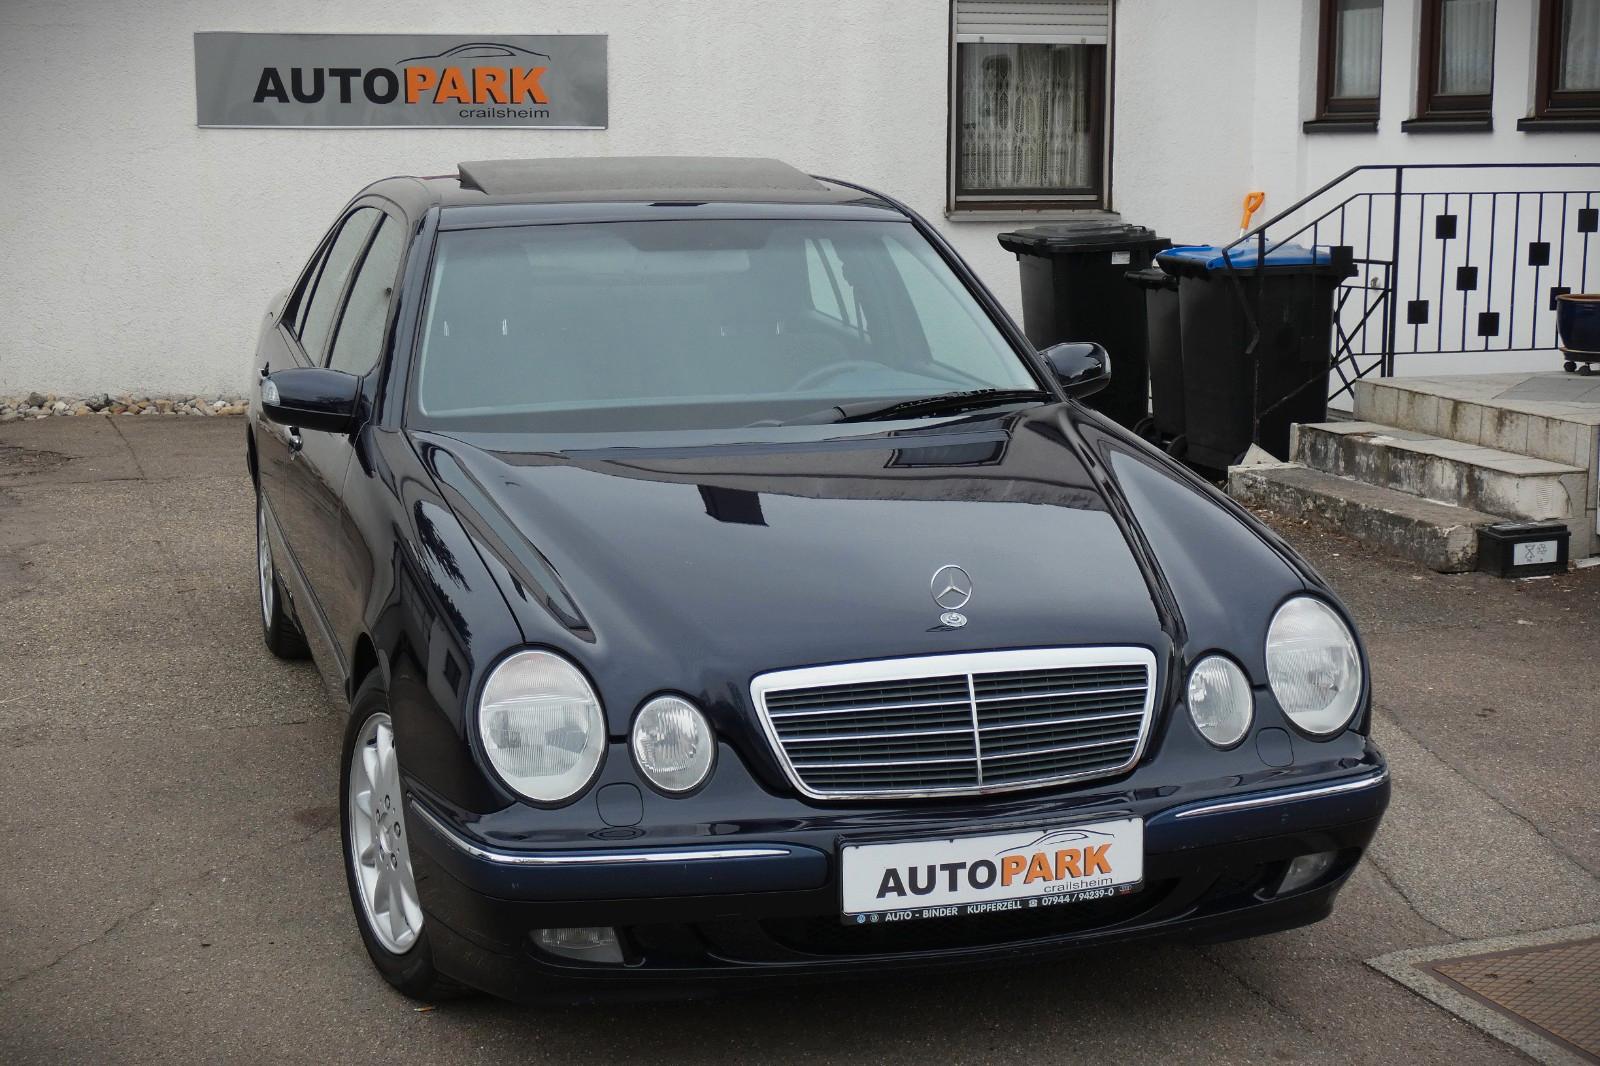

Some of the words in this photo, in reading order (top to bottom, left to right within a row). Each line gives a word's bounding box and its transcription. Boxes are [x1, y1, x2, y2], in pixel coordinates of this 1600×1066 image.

[253, 66, 550, 104] AUTOPARK
[459, 107, 550, 119] crailsheim
[876, 843, 1113, 899] AUTOPARK
[1043, 876, 1113, 893] crailsheim
[885, 911, 912, 922] AUTO
[922, 907, 958, 918] BINDER
[967, 900, 1022, 914] KUPFERZELL
[1042, 895, 1070, 906] 07944
[1078, 888, 1114, 901] 94239-0
